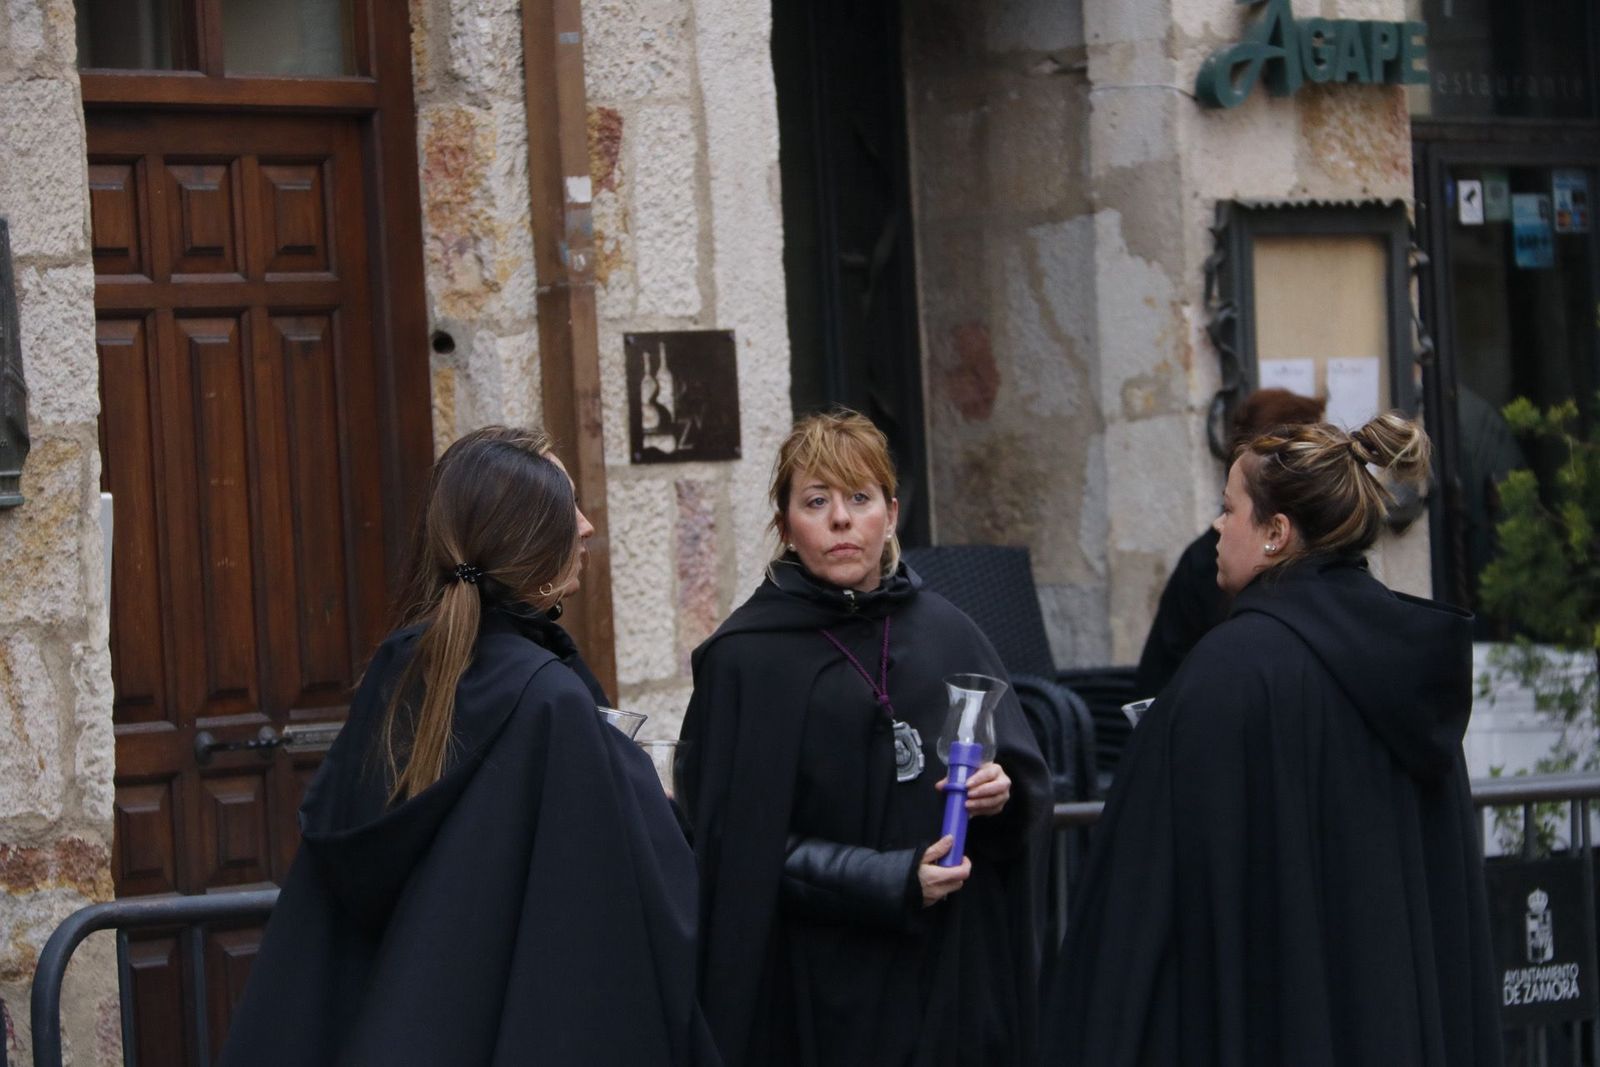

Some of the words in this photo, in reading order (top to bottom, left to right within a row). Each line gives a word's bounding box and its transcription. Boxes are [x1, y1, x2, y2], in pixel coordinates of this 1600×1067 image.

[1436, 71, 1583, 97] estaurante
[1503, 962, 1579, 984] AYUNTAMIENTO
[1503, 985, 1521, 1005] DE
[1522, 978, 1580, 1004] ZAMORA
